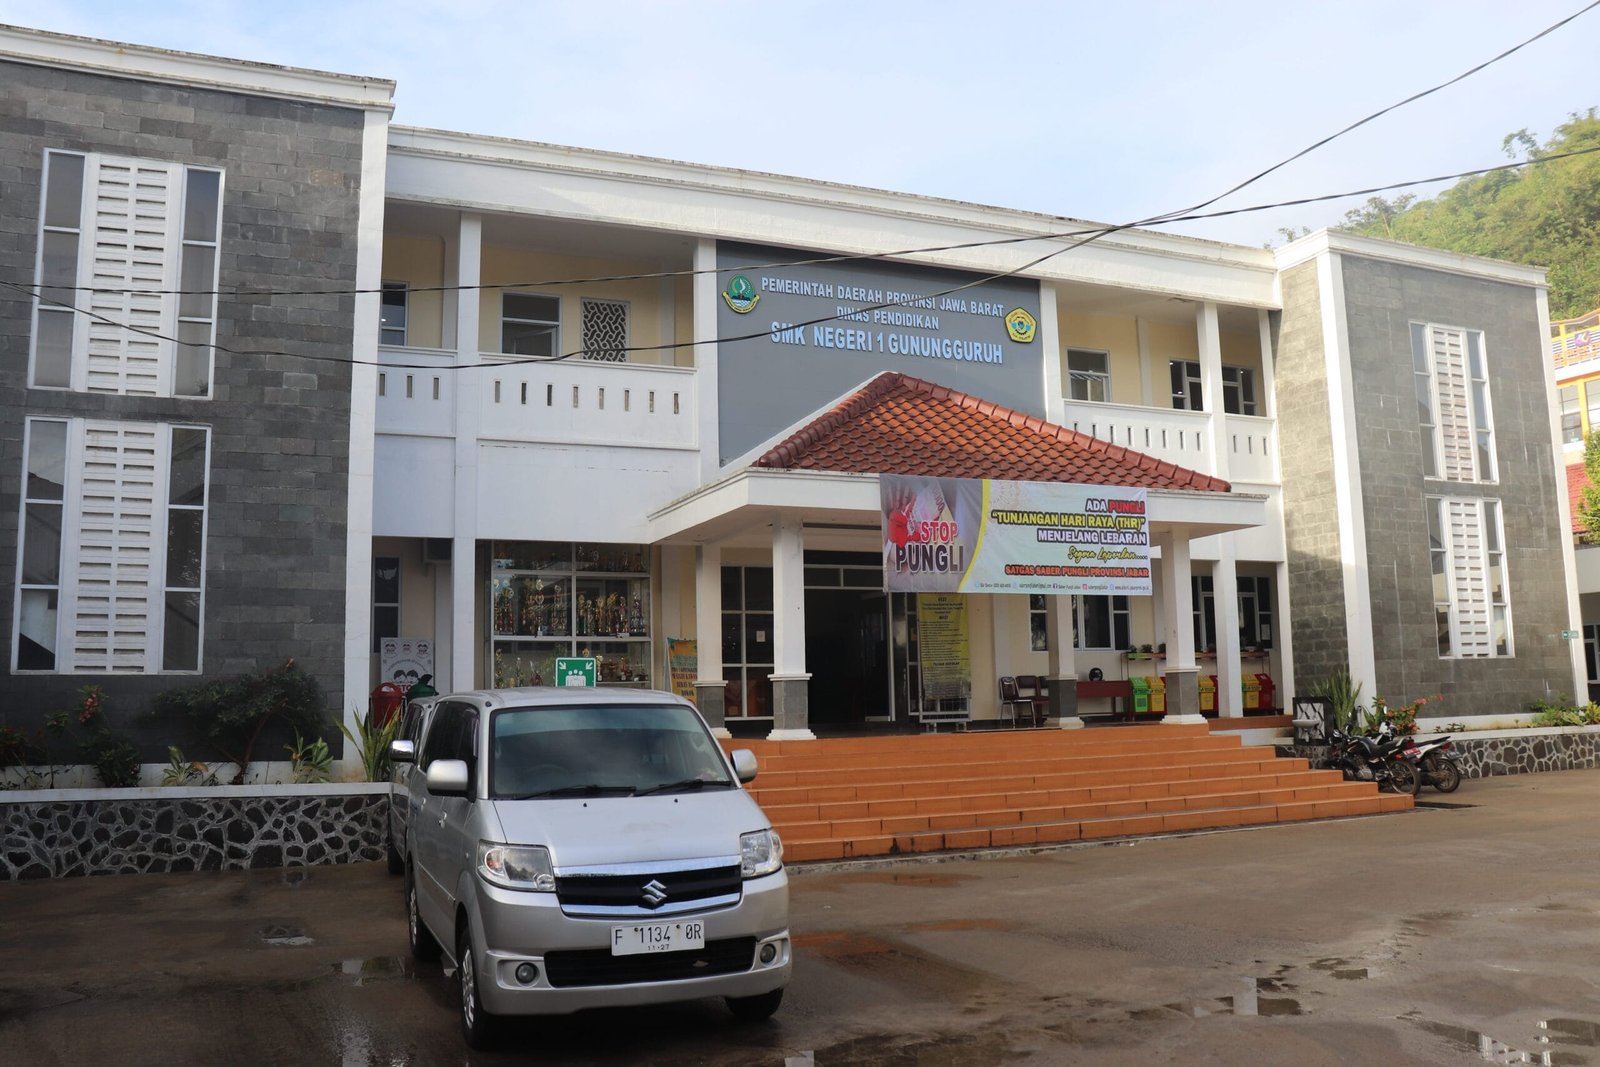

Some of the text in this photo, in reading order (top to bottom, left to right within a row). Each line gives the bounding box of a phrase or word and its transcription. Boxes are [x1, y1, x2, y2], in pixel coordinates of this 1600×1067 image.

[761, 277, 1004, 318] PEMERINTAH DAERAH PROVINSI JAWA BARAT
[836, 306, 940, 330] DINAS PENDIDIKAN
[771, 321, 1003, 364] SMK NEGERI 1 GUNUNGGURUH
[1085, 499, 1145, 514] ADA PUNGLI
[1060, 514, 1086, 527] HARI
[1088, 516, 1114, 529] RAYA
[920, 521, 958, 544] STOP
[1037, 529, 1147, 546] MENJELANG LEBARAN
[896, 544, 964, 573] PUNGLI
[1004, 565, 1149, 578] SATGAS SABER PUNGLI PROVINSI JABAR
[615, 929, 623, 945] F
[640, 926, 671, 944] 1134
